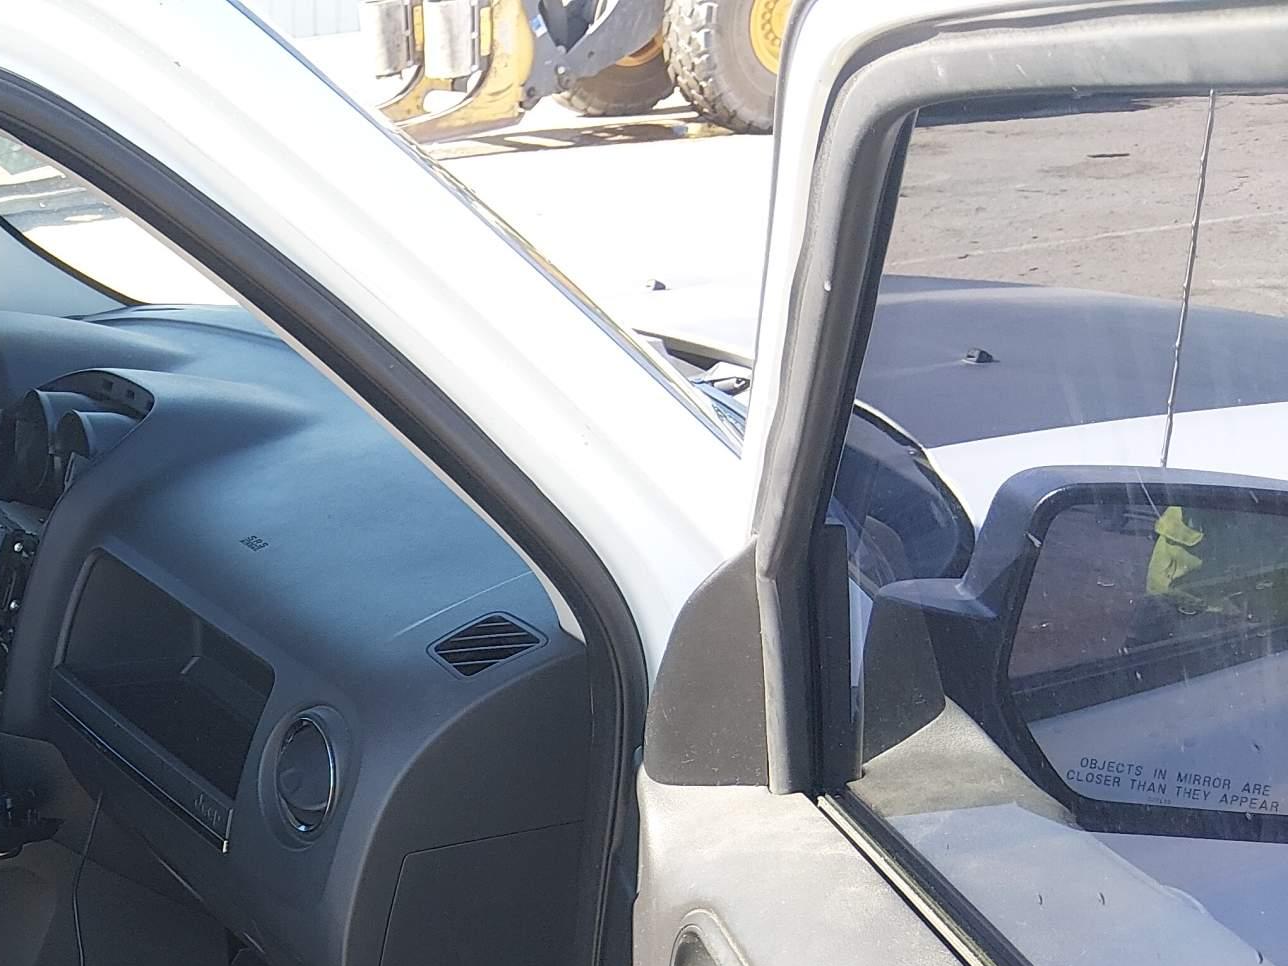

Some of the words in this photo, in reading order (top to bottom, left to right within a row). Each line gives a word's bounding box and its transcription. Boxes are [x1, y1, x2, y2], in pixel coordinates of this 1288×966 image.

[1066, 769, 1121, 787] CLOSER
[1130, 779, 1167, 794] THAN
[1176, 786, 1211, 801] THEY
[1220, 793, 1280, 812] APPEAR
[1080, 757, 1143, 777] OBJECTS
[1153, 768, 1167, 780] IN
[1176, 771, 1231, 790] MIRROR
[1241, 782, 1272, 796] ARE
